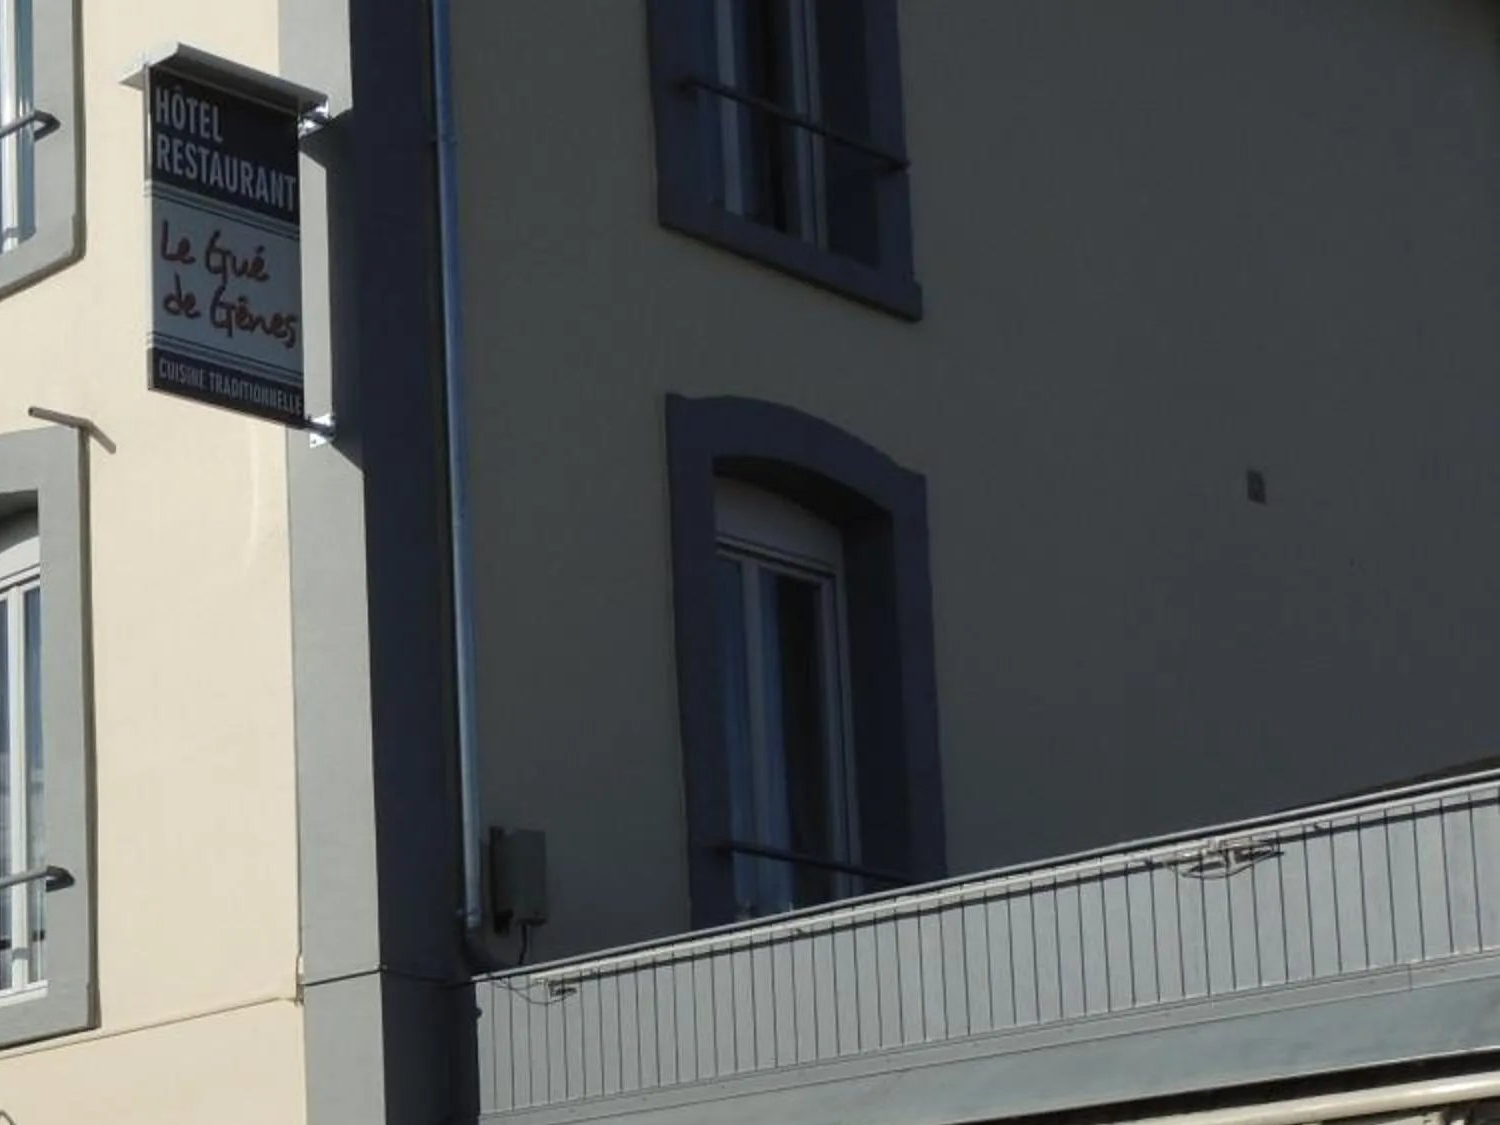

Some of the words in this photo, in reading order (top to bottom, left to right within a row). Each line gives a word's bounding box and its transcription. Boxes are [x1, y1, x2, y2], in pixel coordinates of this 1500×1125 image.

[155, 84, 225, 143] HÔTEL
[156, 132, 297, 212] RESTAURANT
[161, 220, 197, 264] Le
[204, 229, 269, 287] Gué
[163, 273, 201, 319] de
[209, 285, 299, 349] Gênes
[159, 356, 207, 391] CUISINE
[209, 371, 304, 416] TRADITIONNELLE
